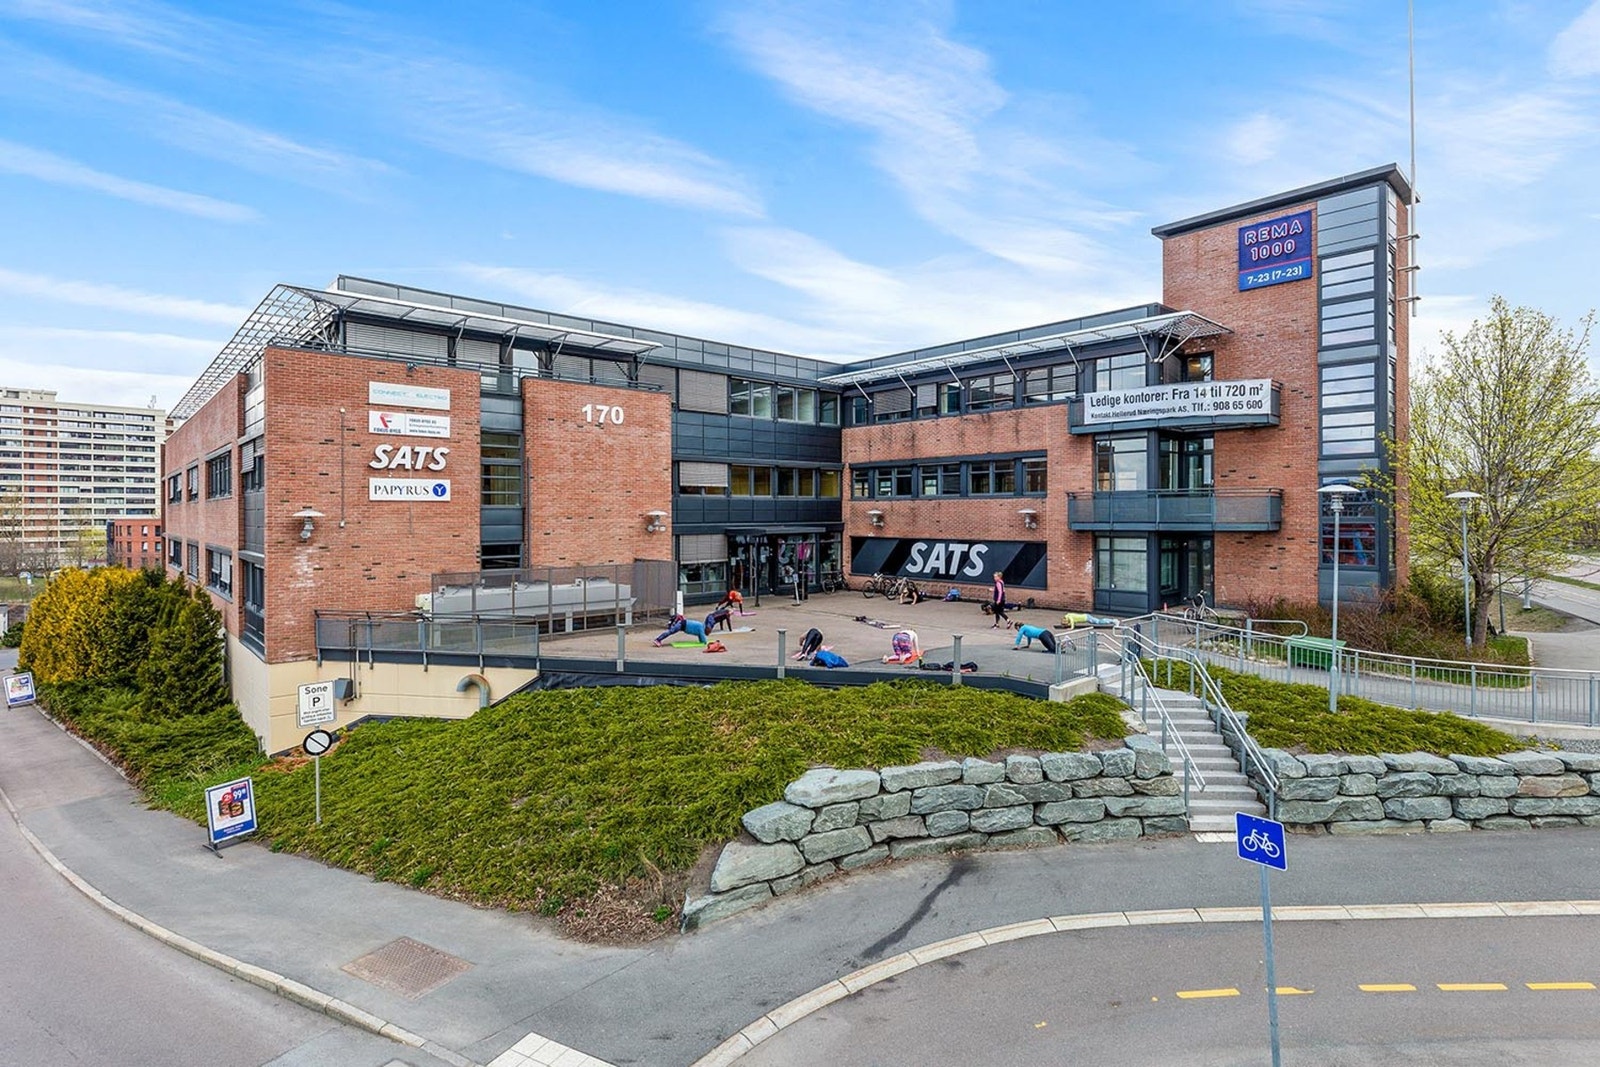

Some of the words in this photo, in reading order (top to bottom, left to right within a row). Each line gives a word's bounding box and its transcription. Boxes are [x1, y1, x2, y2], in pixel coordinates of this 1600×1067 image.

[1244, 219, 1303, 246] REMA
[1251, 239, 1295, 261] 1000
[1247, 273, 1270, 285] 7-23
[1272, 265, 1303, 280] (7-23)
[1090, 395, 1121, 408] Ledige
[1123, 391, 1169, 405] kontorer:
[1172, 388, 1190, 400] Fra
[1193, 386, 1207, 399] 14
[1210, 385, 1222, 398] til
[1225, 384, 1246, 397] 720
[1213, 400, 1230, 411] 908
[1232, 400, 1244, 410] 65
[581, 403, 625, 425] 170
[368, 443, 450, 471] SATS
[374, 485, 430, 496] PAPYRUS
[905, 541, 989, 577] SATS
[304, 685, 328, 695] Sone
[312, 696, 320, 707] P
